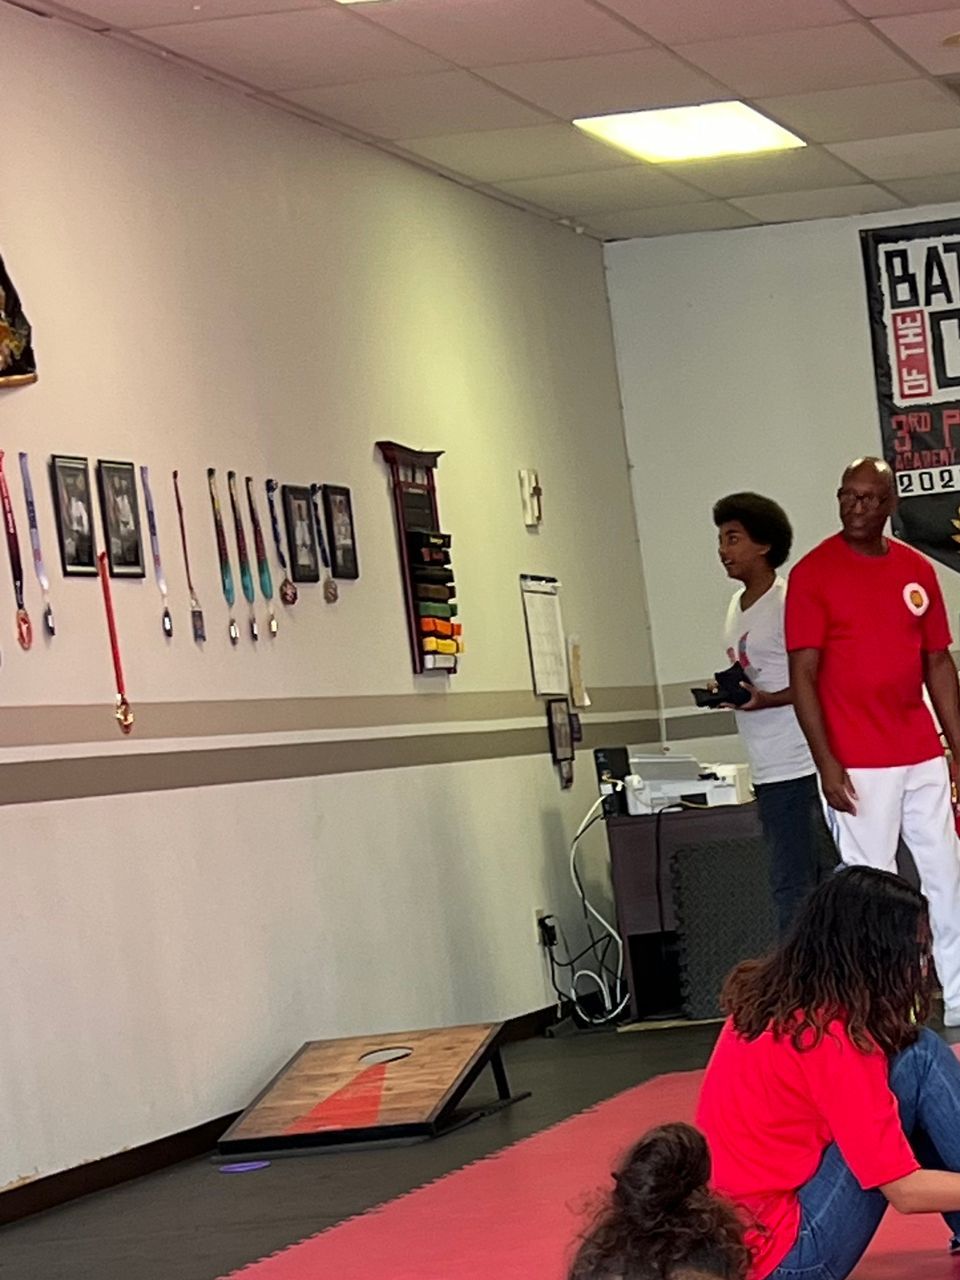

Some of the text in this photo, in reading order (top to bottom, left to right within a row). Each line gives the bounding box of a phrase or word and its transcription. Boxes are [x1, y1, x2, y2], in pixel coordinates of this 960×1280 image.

[898, 311, 929, 396] OF THE
[890, 411, 931, 451] 3RD
